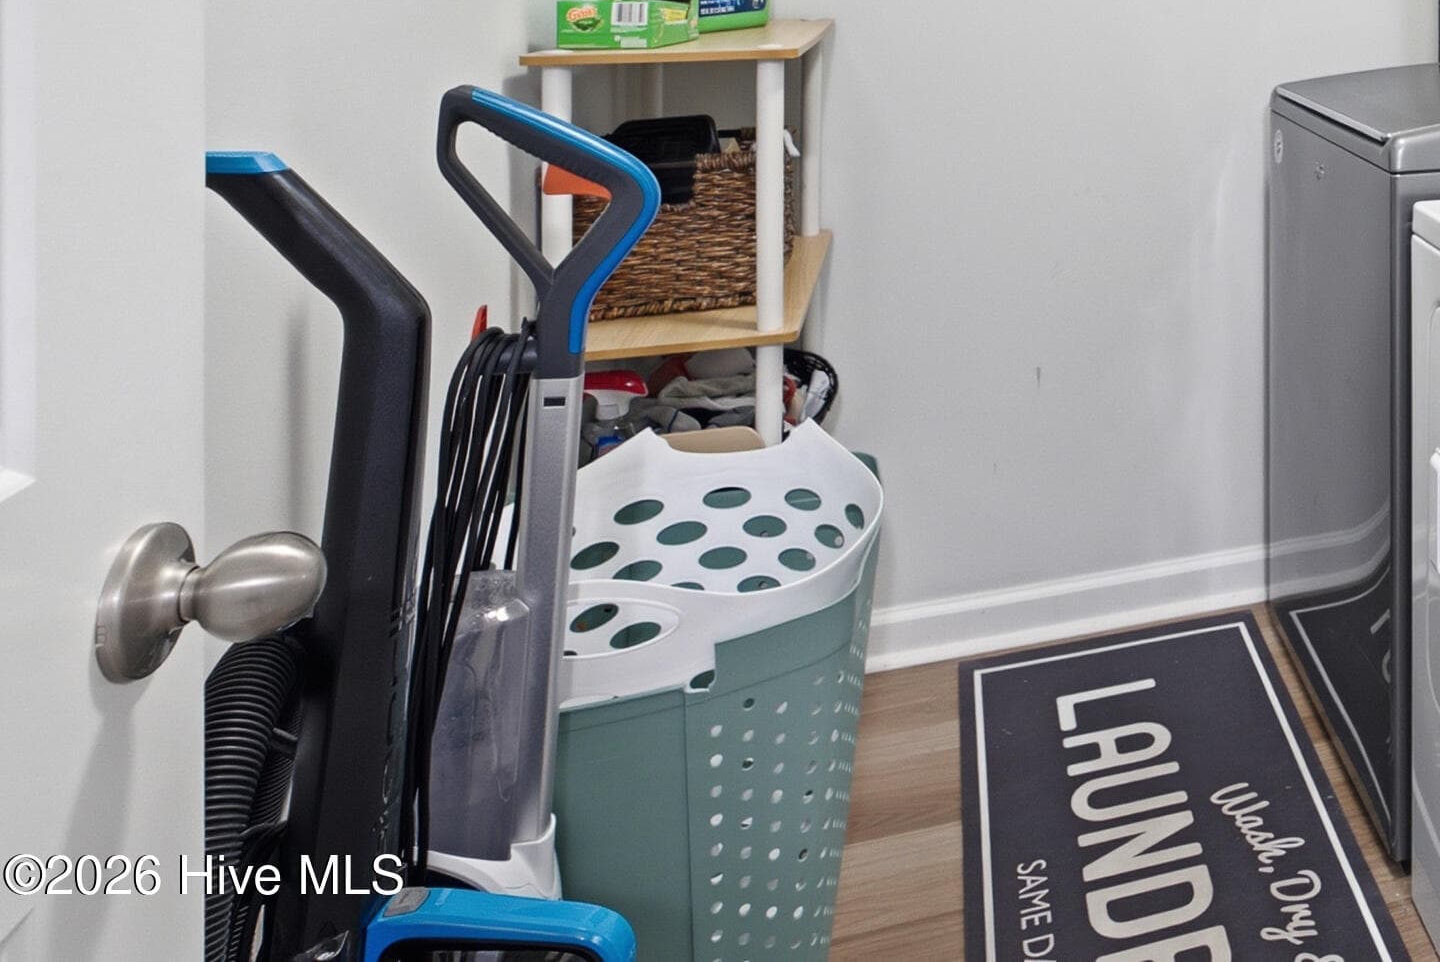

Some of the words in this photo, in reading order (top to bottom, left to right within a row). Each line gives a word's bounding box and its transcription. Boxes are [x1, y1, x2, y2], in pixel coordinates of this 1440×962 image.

[1017, 859, 1053, 930] SAME
[1210, 782, 1305, 873] Wash,
[1260, 869, 1321, 945] Dry
[1022, 934, 1057, 962] D
